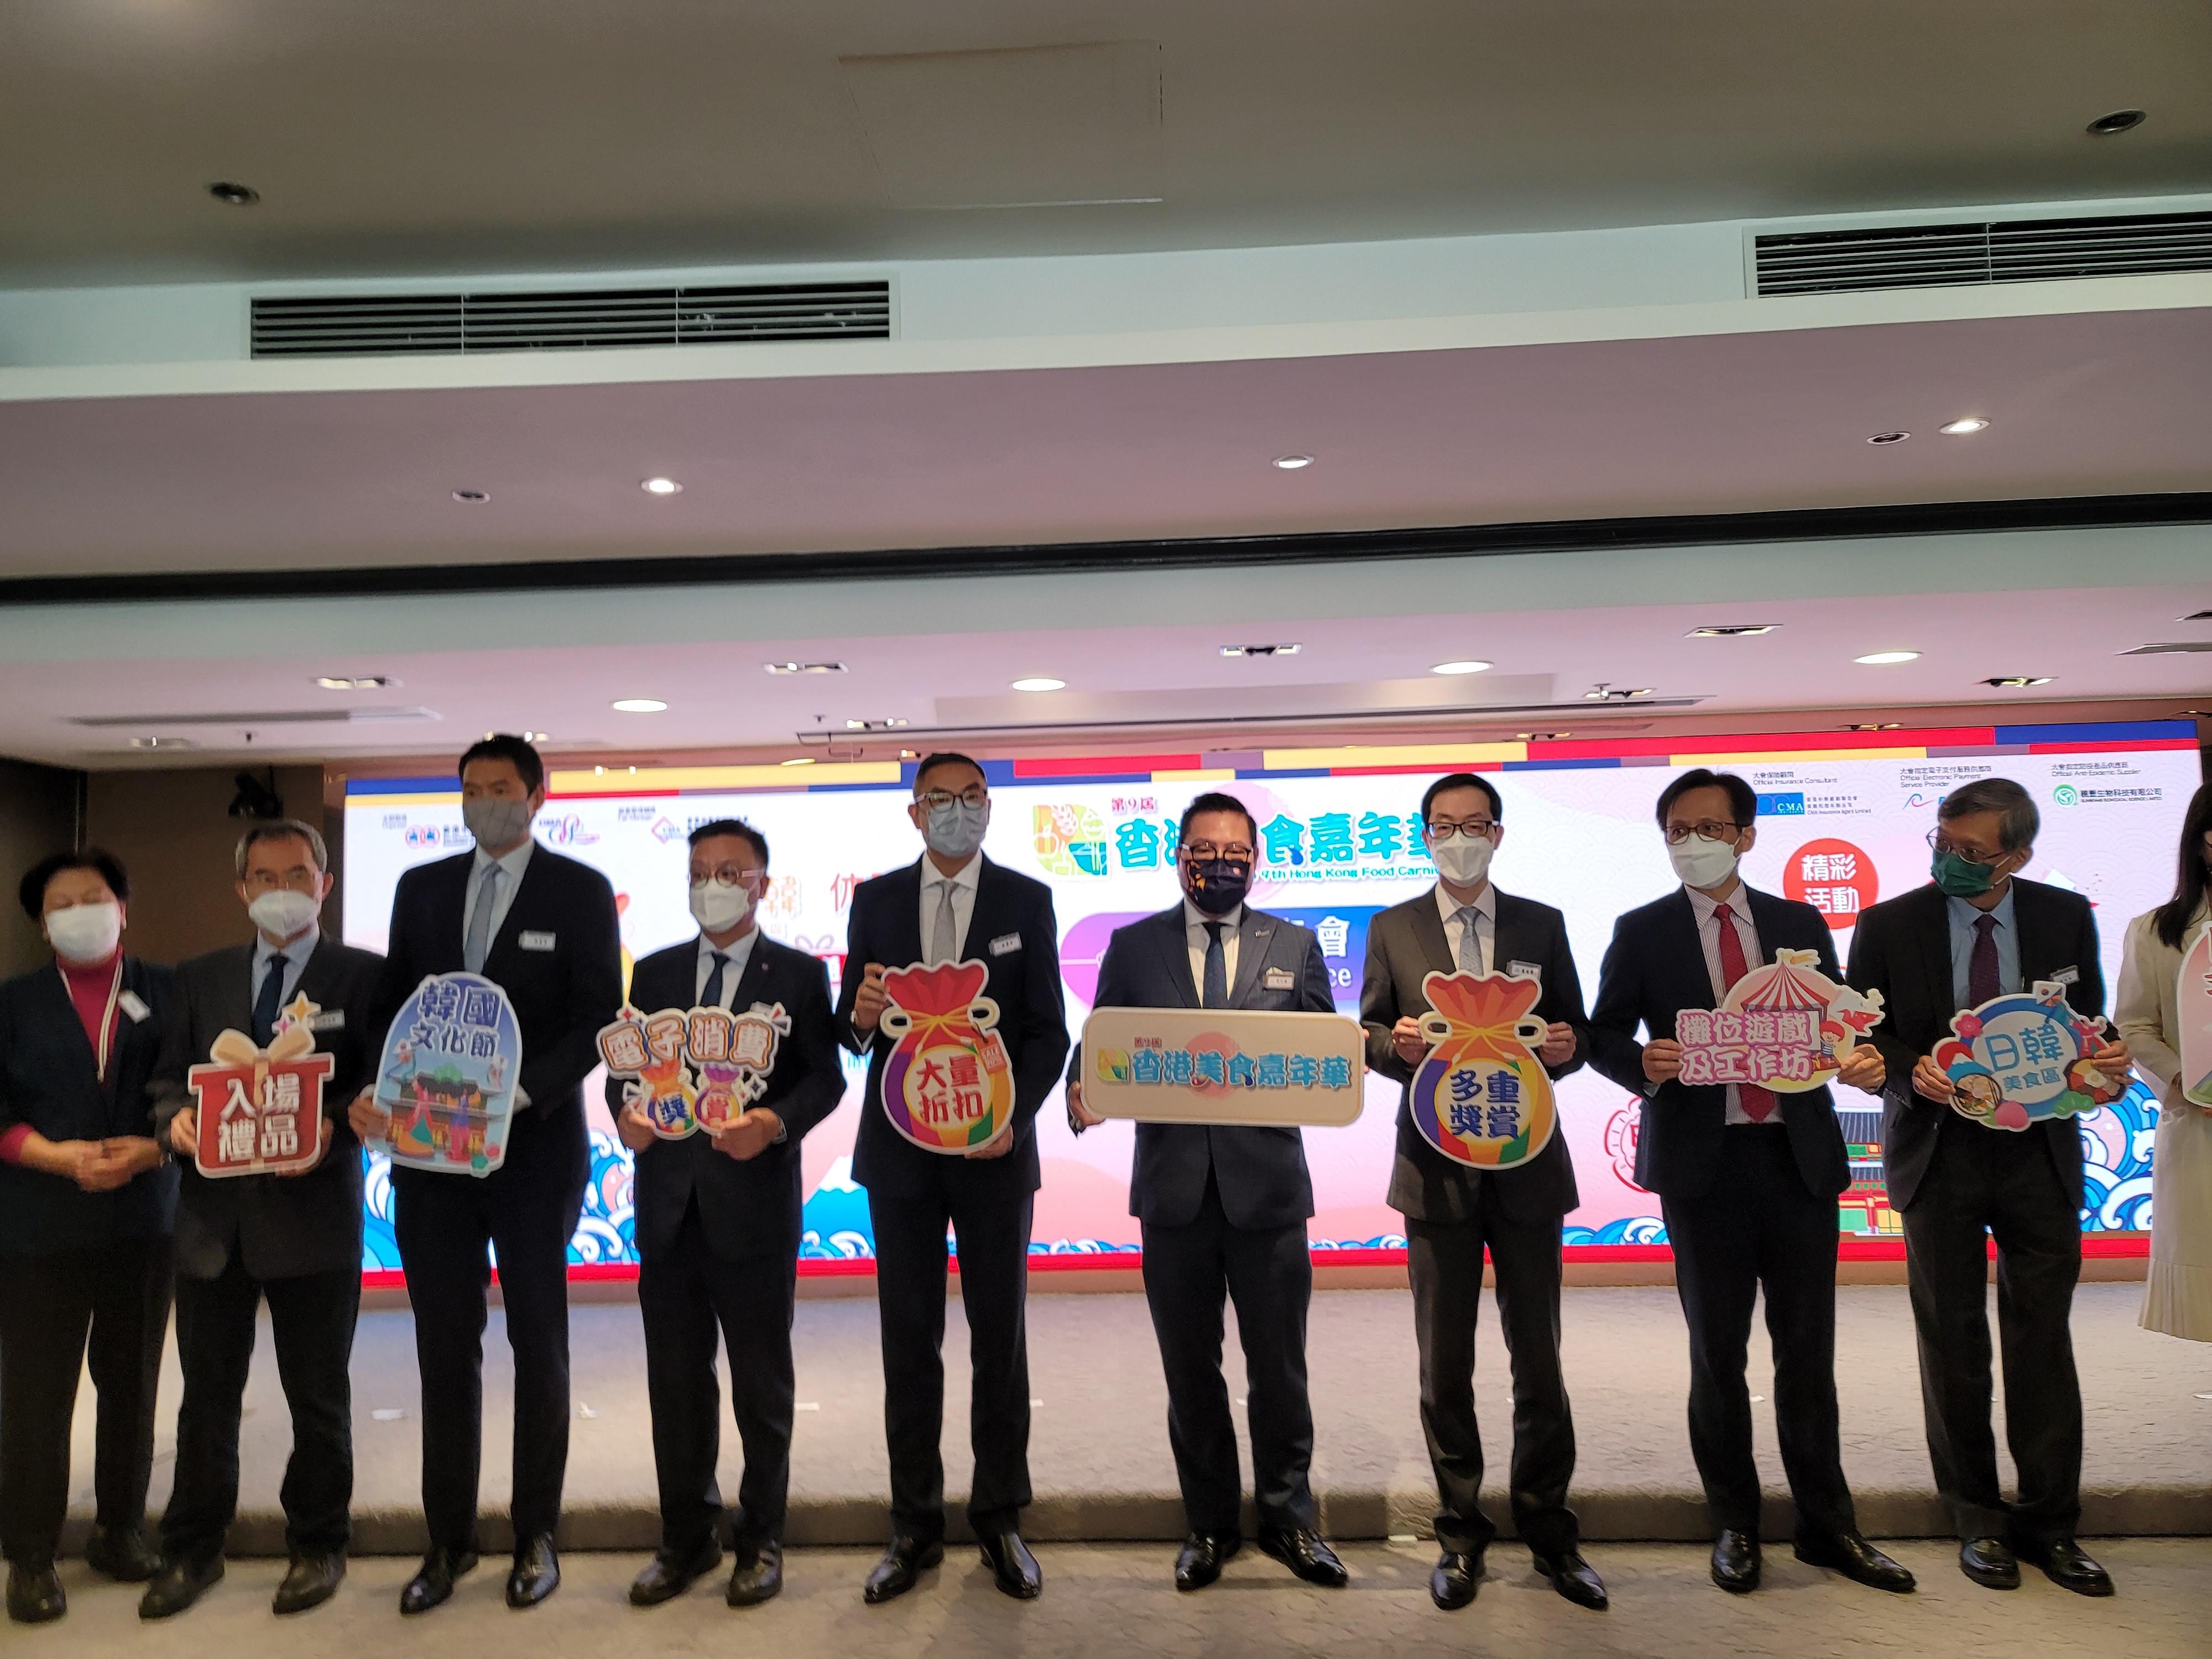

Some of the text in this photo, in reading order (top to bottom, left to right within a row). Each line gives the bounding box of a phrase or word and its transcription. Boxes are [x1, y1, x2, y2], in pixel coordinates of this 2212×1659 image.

[1777, 802, 1804, 811] CMA
[1290, 869, 1321, 879] Hong
[1326, 868, 1357, 878] Kong
[1362, 867, 1394, 877] Food
[1801, 853, 1857, 881] 精彩
[1804, 886, 1860, 914] 活動
[419, 982, 502, 1029] 韓國
[411, 1021, 499, 1058] 文化節
[1680, 1011, 1812, 1046] 攤位遊戲
[1681, 1046, 1813, 1081] 及工作坊
[1985, 1023, 2064, 1072] 日韓
[916, 1055, 980, 1091] 大量
[1132, 1048, 1350, 1089] 香港美食嘉年華
[1449, 1069, 1520, 1103] 多重
[2003, 1066, 2062, 1092] 美食區
[220, 1073, 300, 1120] 入場
[919, 1088, 983, 1123] 折扣
[219, 1113, 299, 1162] 禮品
[1449, 1104, 1520, 1140] 獎賞
